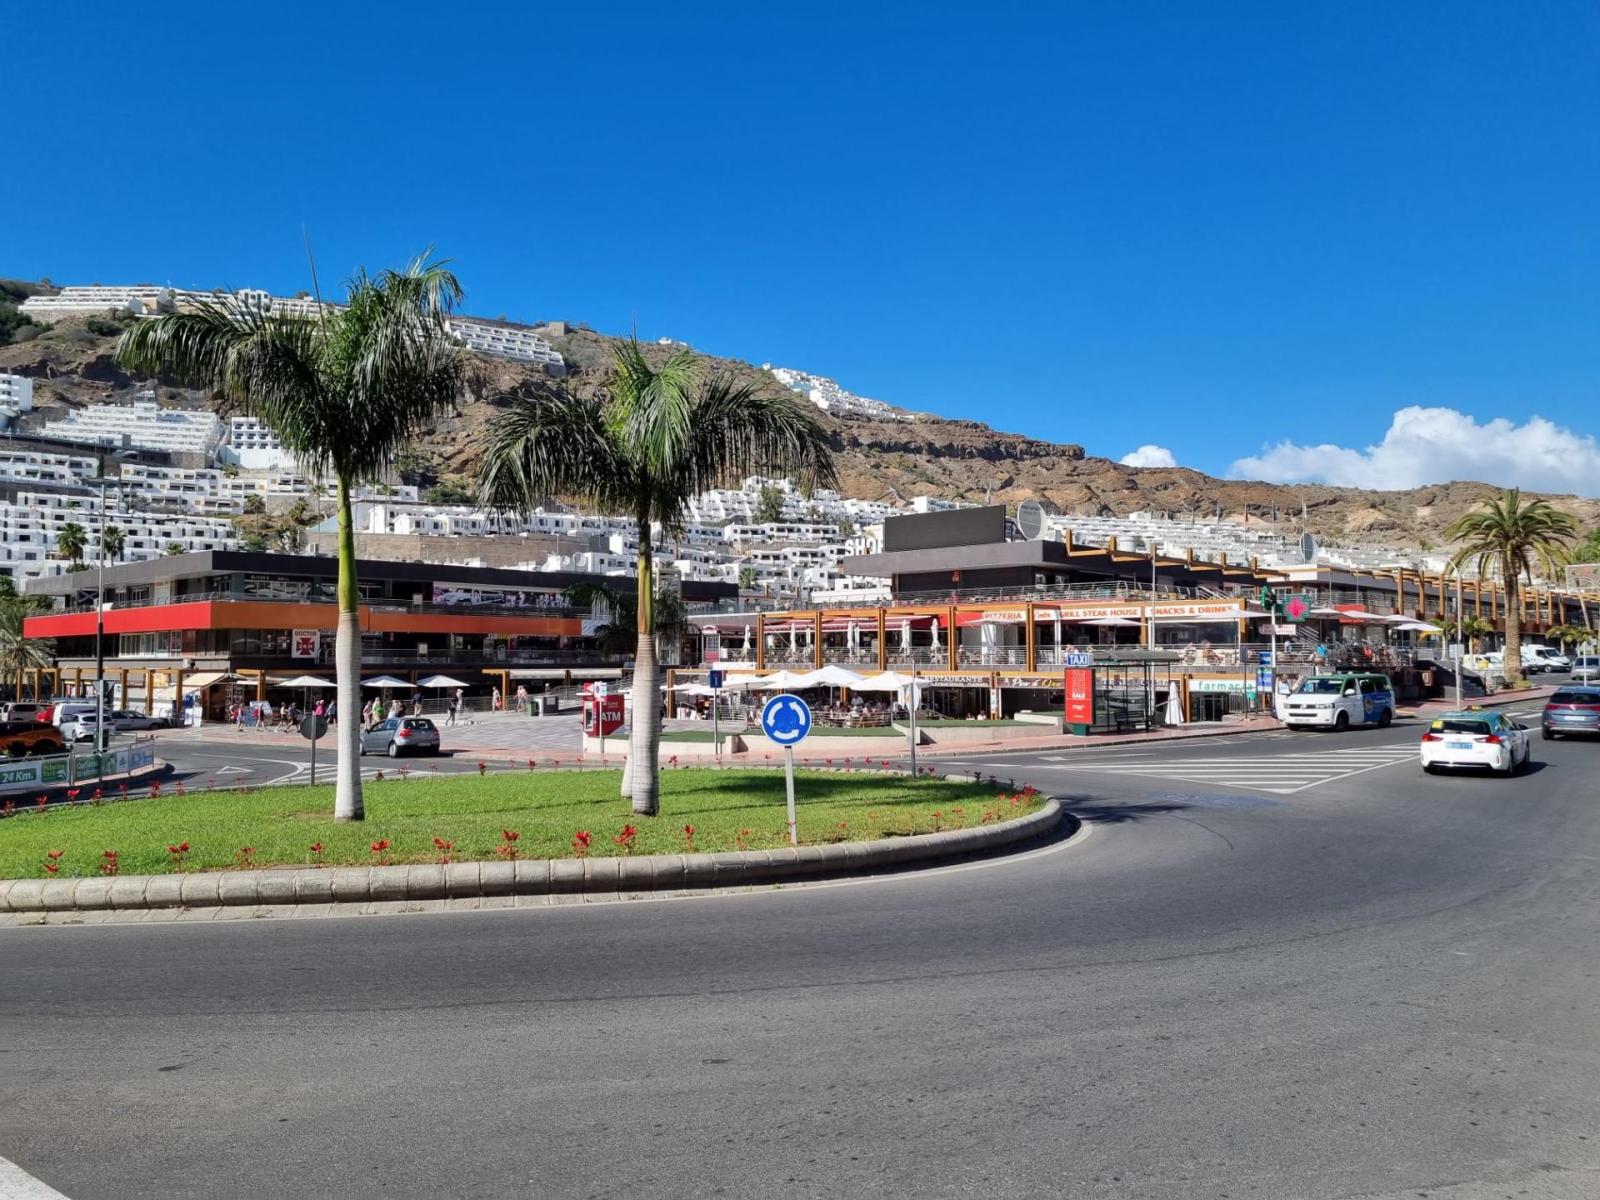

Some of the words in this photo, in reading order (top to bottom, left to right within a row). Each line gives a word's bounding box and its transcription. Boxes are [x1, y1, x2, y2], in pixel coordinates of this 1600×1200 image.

[1110, 608, 1138, 616] HOUSE
[1151, 607, 1185, 615] SNACKS
[1189, 606, 1195, 614] &
[1198, 605, 1233, 614] DRINKS
[984, 612, 1022, 620] PIZZERIA
[1069, 654, 1088, 665] TAXI
[1198, 681, 1253, 689] farmaca
[601, 711, 621, 721] ATM
